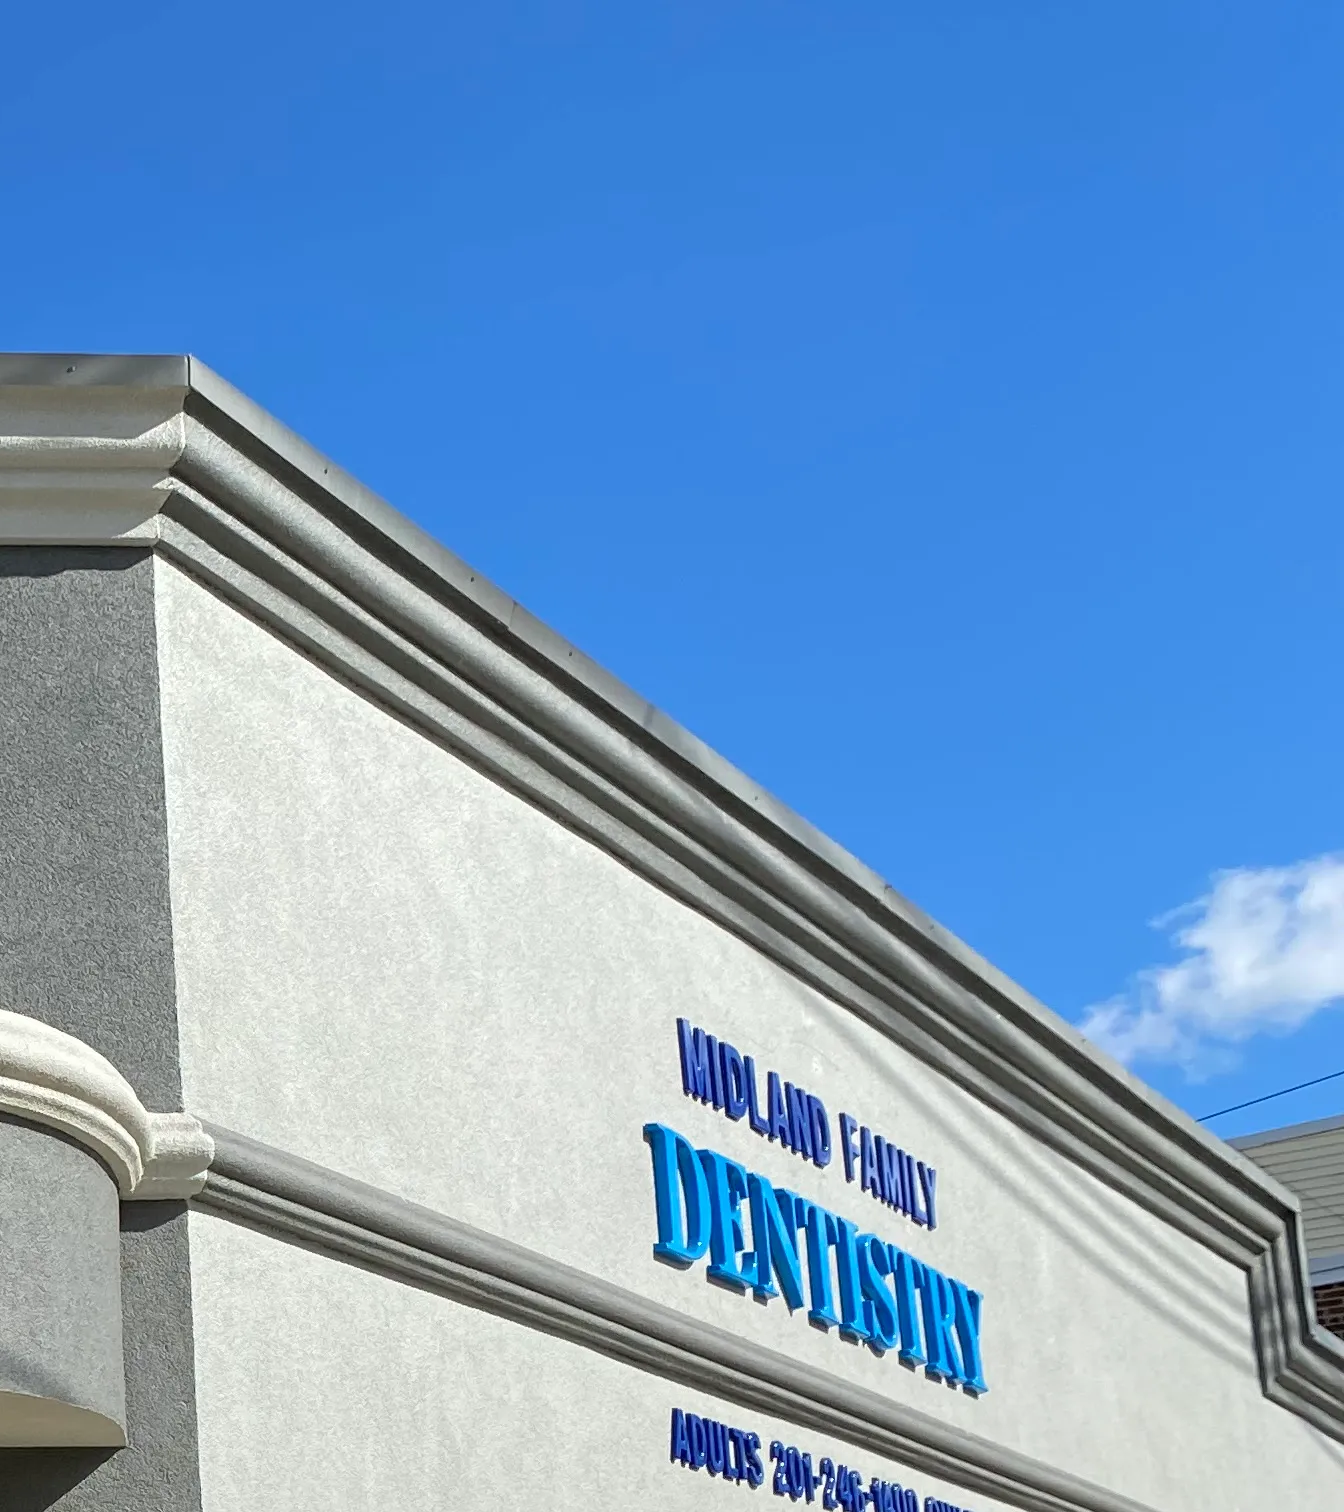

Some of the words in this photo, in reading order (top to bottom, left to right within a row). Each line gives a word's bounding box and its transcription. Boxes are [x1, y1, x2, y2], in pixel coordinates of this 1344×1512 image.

[677, 1018, 832, 1168] MIDLAND
[839, 1112, 937, 1230] FAMILY
[643, 1123, 988, 1397] DENTISTRY
[671, 1407, 764, 1488] ADULTS
